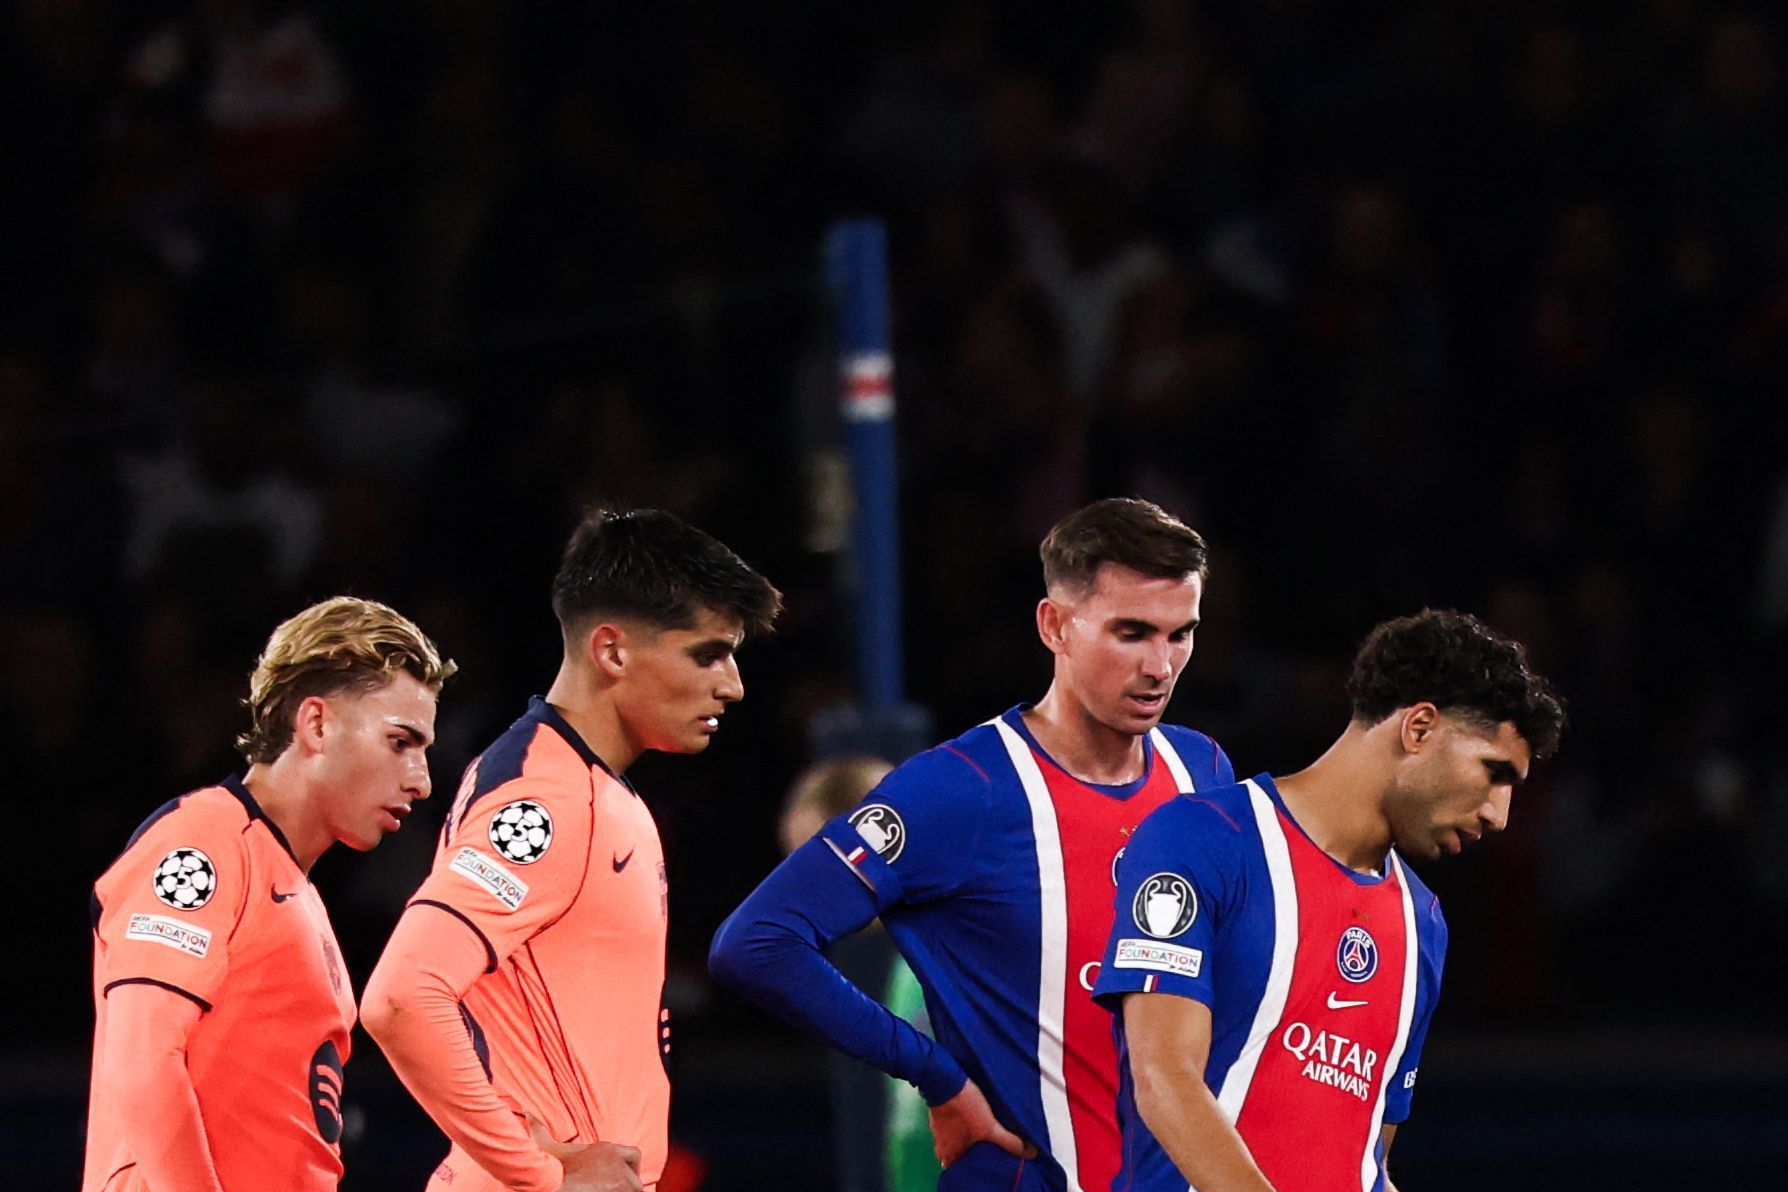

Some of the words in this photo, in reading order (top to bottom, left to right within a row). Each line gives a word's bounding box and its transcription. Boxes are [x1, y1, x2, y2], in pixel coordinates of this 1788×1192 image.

[458, 854, 523, 902] FOUNDATION
[130, 922, 208, 949] FOUNDATION
[1119, 949, 1198, 967] FOUNDATION
[1283, 1022, 1377, 1082] QATAR
[1301, 1060, 1370, 1102] AIRWAYS
